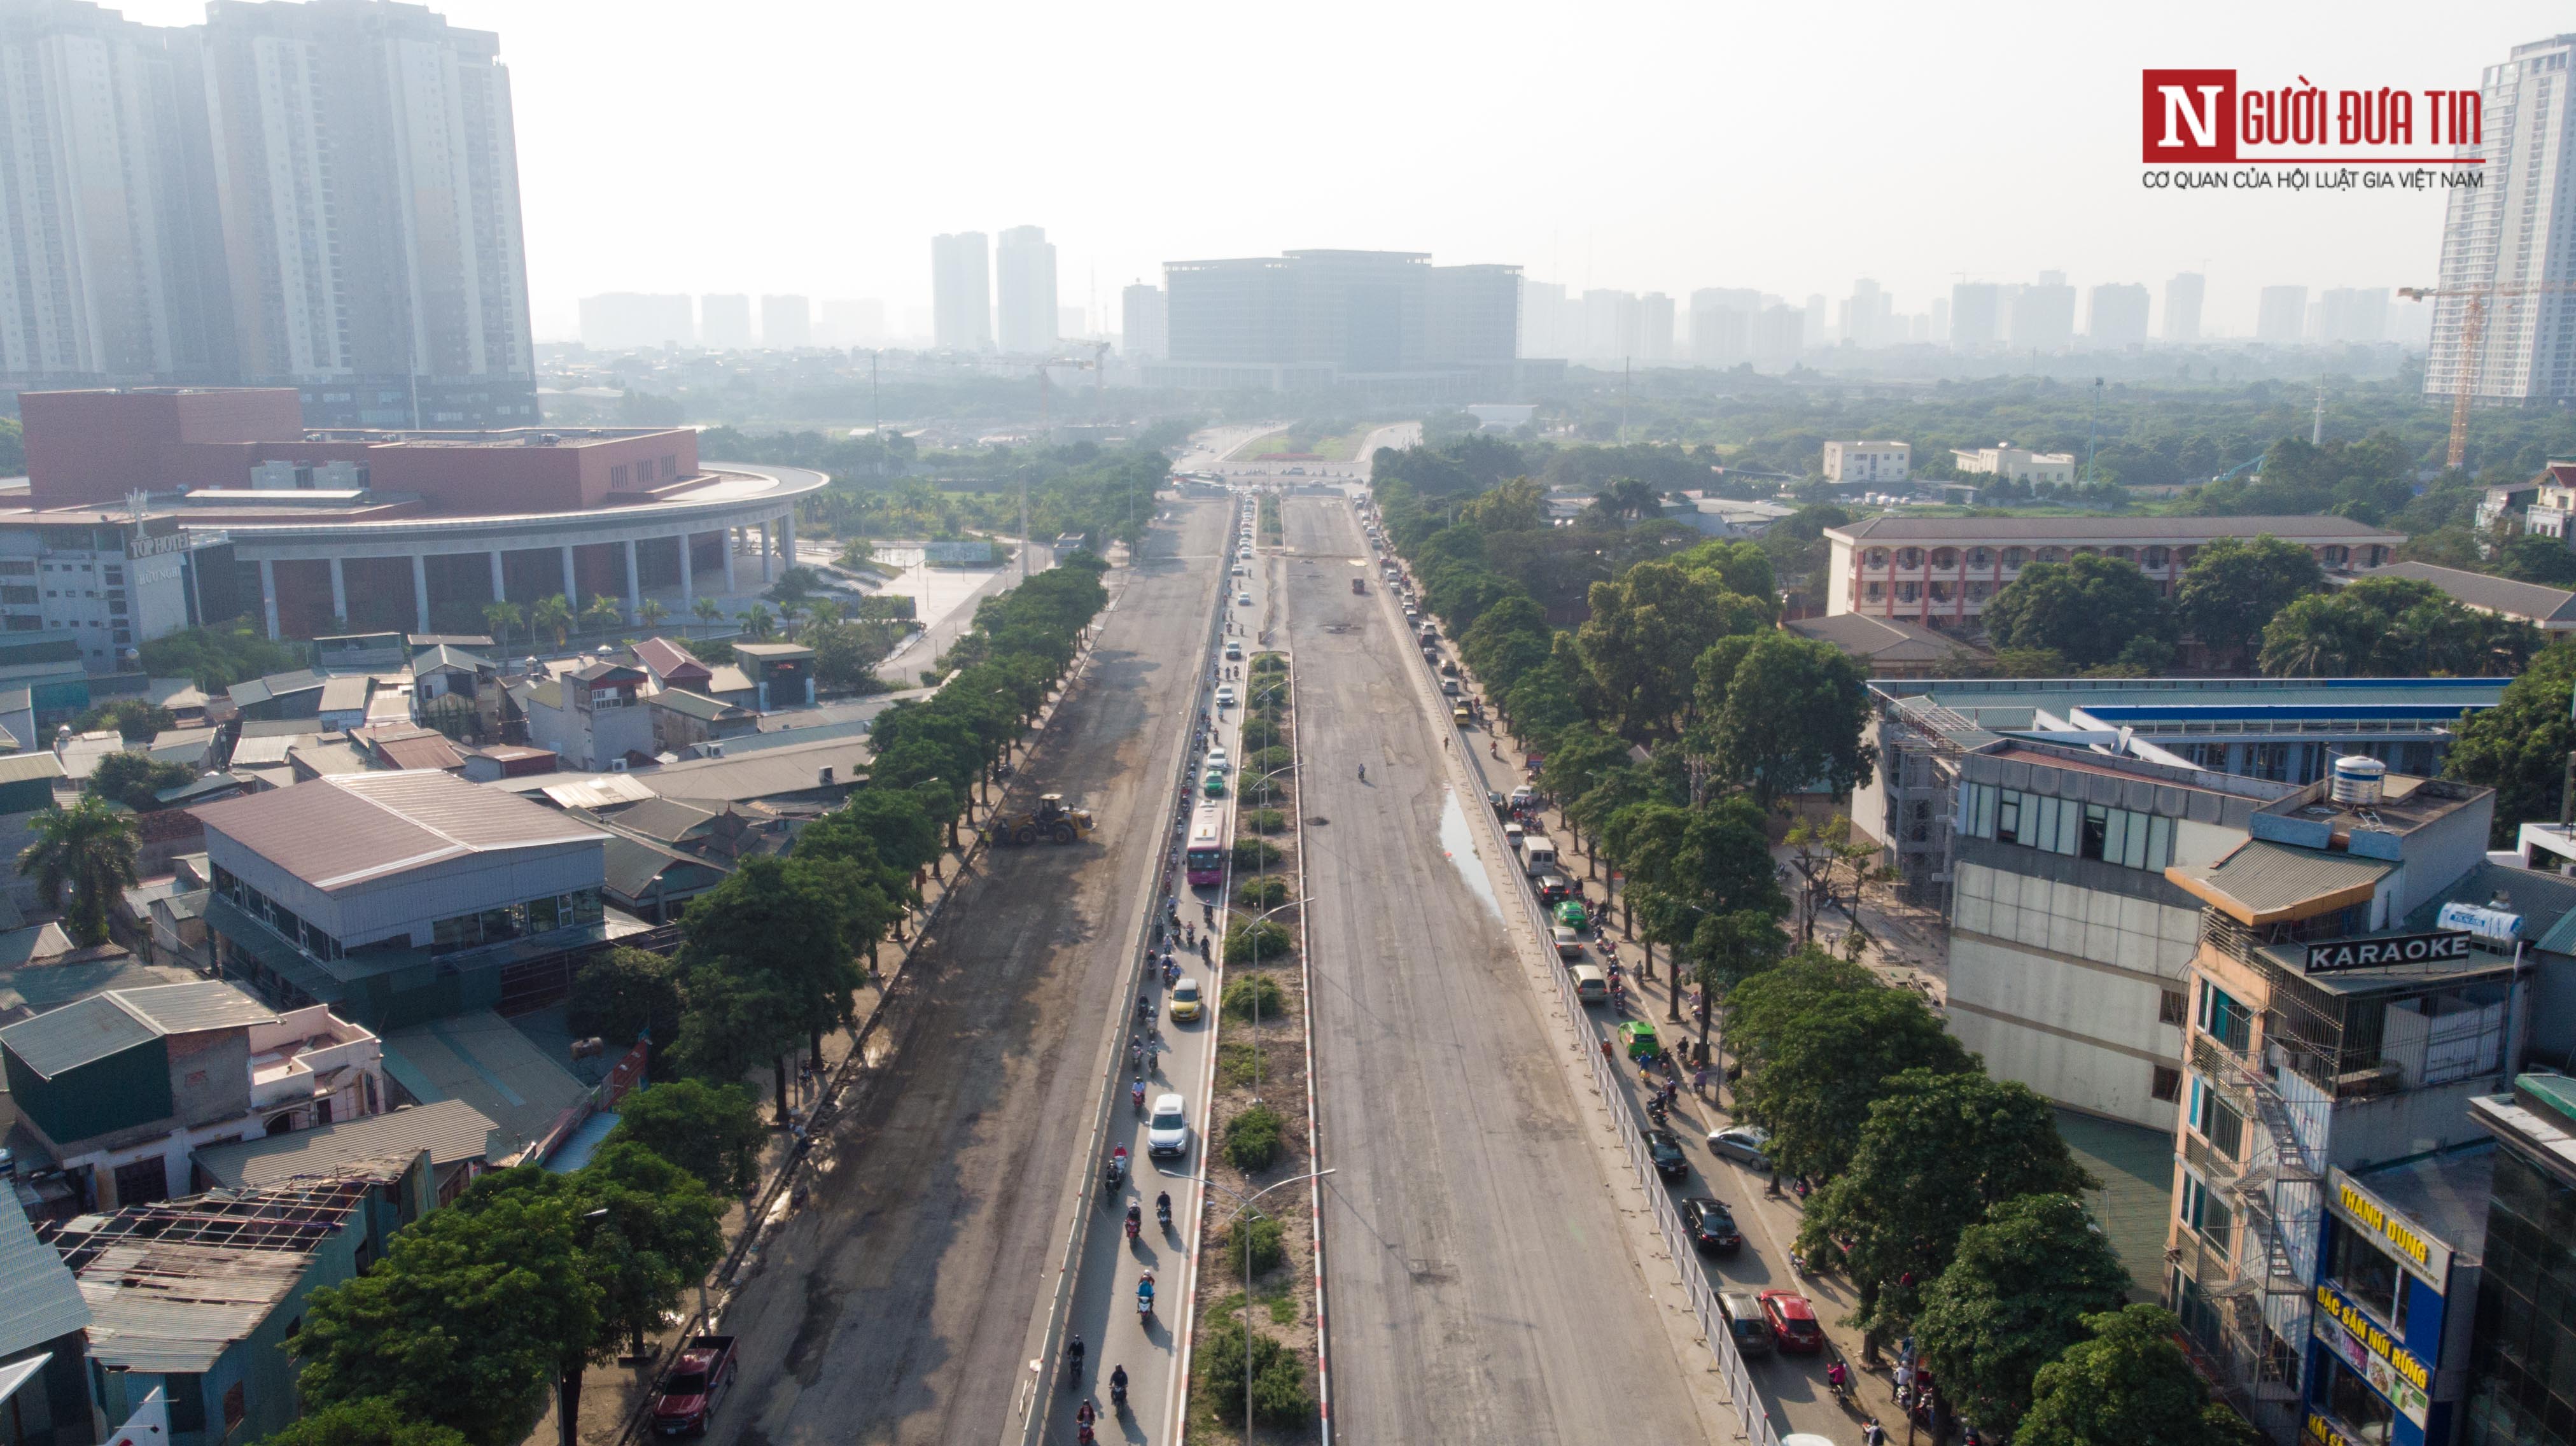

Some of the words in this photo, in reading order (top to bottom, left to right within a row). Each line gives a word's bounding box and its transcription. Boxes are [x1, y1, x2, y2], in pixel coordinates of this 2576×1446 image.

[130, 539, 154, 558] TOP
[153, 533, 188, 554] HOTEL
[2311, 935, 2470, 968] KARAOKE
[2340, 1184, 2384, 1232] THANH
